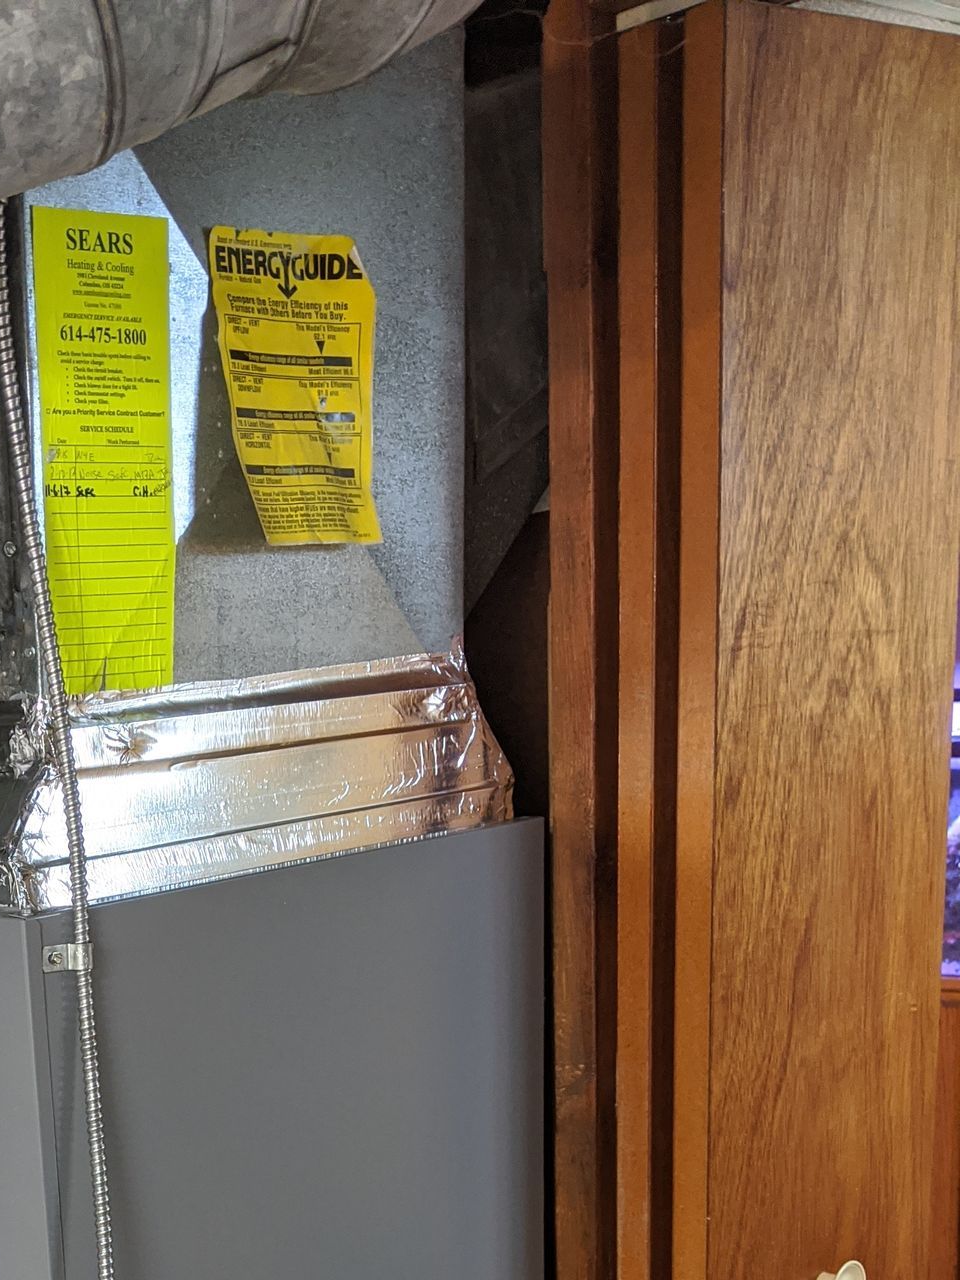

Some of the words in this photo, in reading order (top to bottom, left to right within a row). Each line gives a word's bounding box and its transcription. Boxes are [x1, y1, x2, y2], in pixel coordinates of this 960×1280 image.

[65, 227, 134, 255] SEARS
[67, 258, 95, 272] Heating
[97, 261, 104, 271] &
[105, 262, 134, 276] Cooling
[227, 293, 256, 305] Compare
[256, 297, 267, 306] the
[268, 296, 289, 310] Energy
[290, 299, 322, 311] Efficiency
[323, 302, 331, 310] of
[333, 301, 349, 310] this
[63, 312, 93, 320] EMERGENCY
[230, 302, 255, 314] Furnace
[256, 307, 269, 315] with
[269, 307, 290, 318] Others
[291, 308, 312, 319] Before
[314, 310, 328, 320] You
[329, 310, 347, 321] Buy.
[227, 316, 242, 325] DIRECT
[248, 319, 259, 327] VENT
[305, 324, 326, 332] Model's
[326, 325, 350, 333] Efficiency
[60, 325, 147, 345] 614-475-1800
[232, 375, 247, 383] DIRECT
[52, 407, 62, 415] Are
[76, 408, 96, 417] Priority
[79, 425, 104, 433] SERVICE
[240, 432, 254, 440] DIRECT
